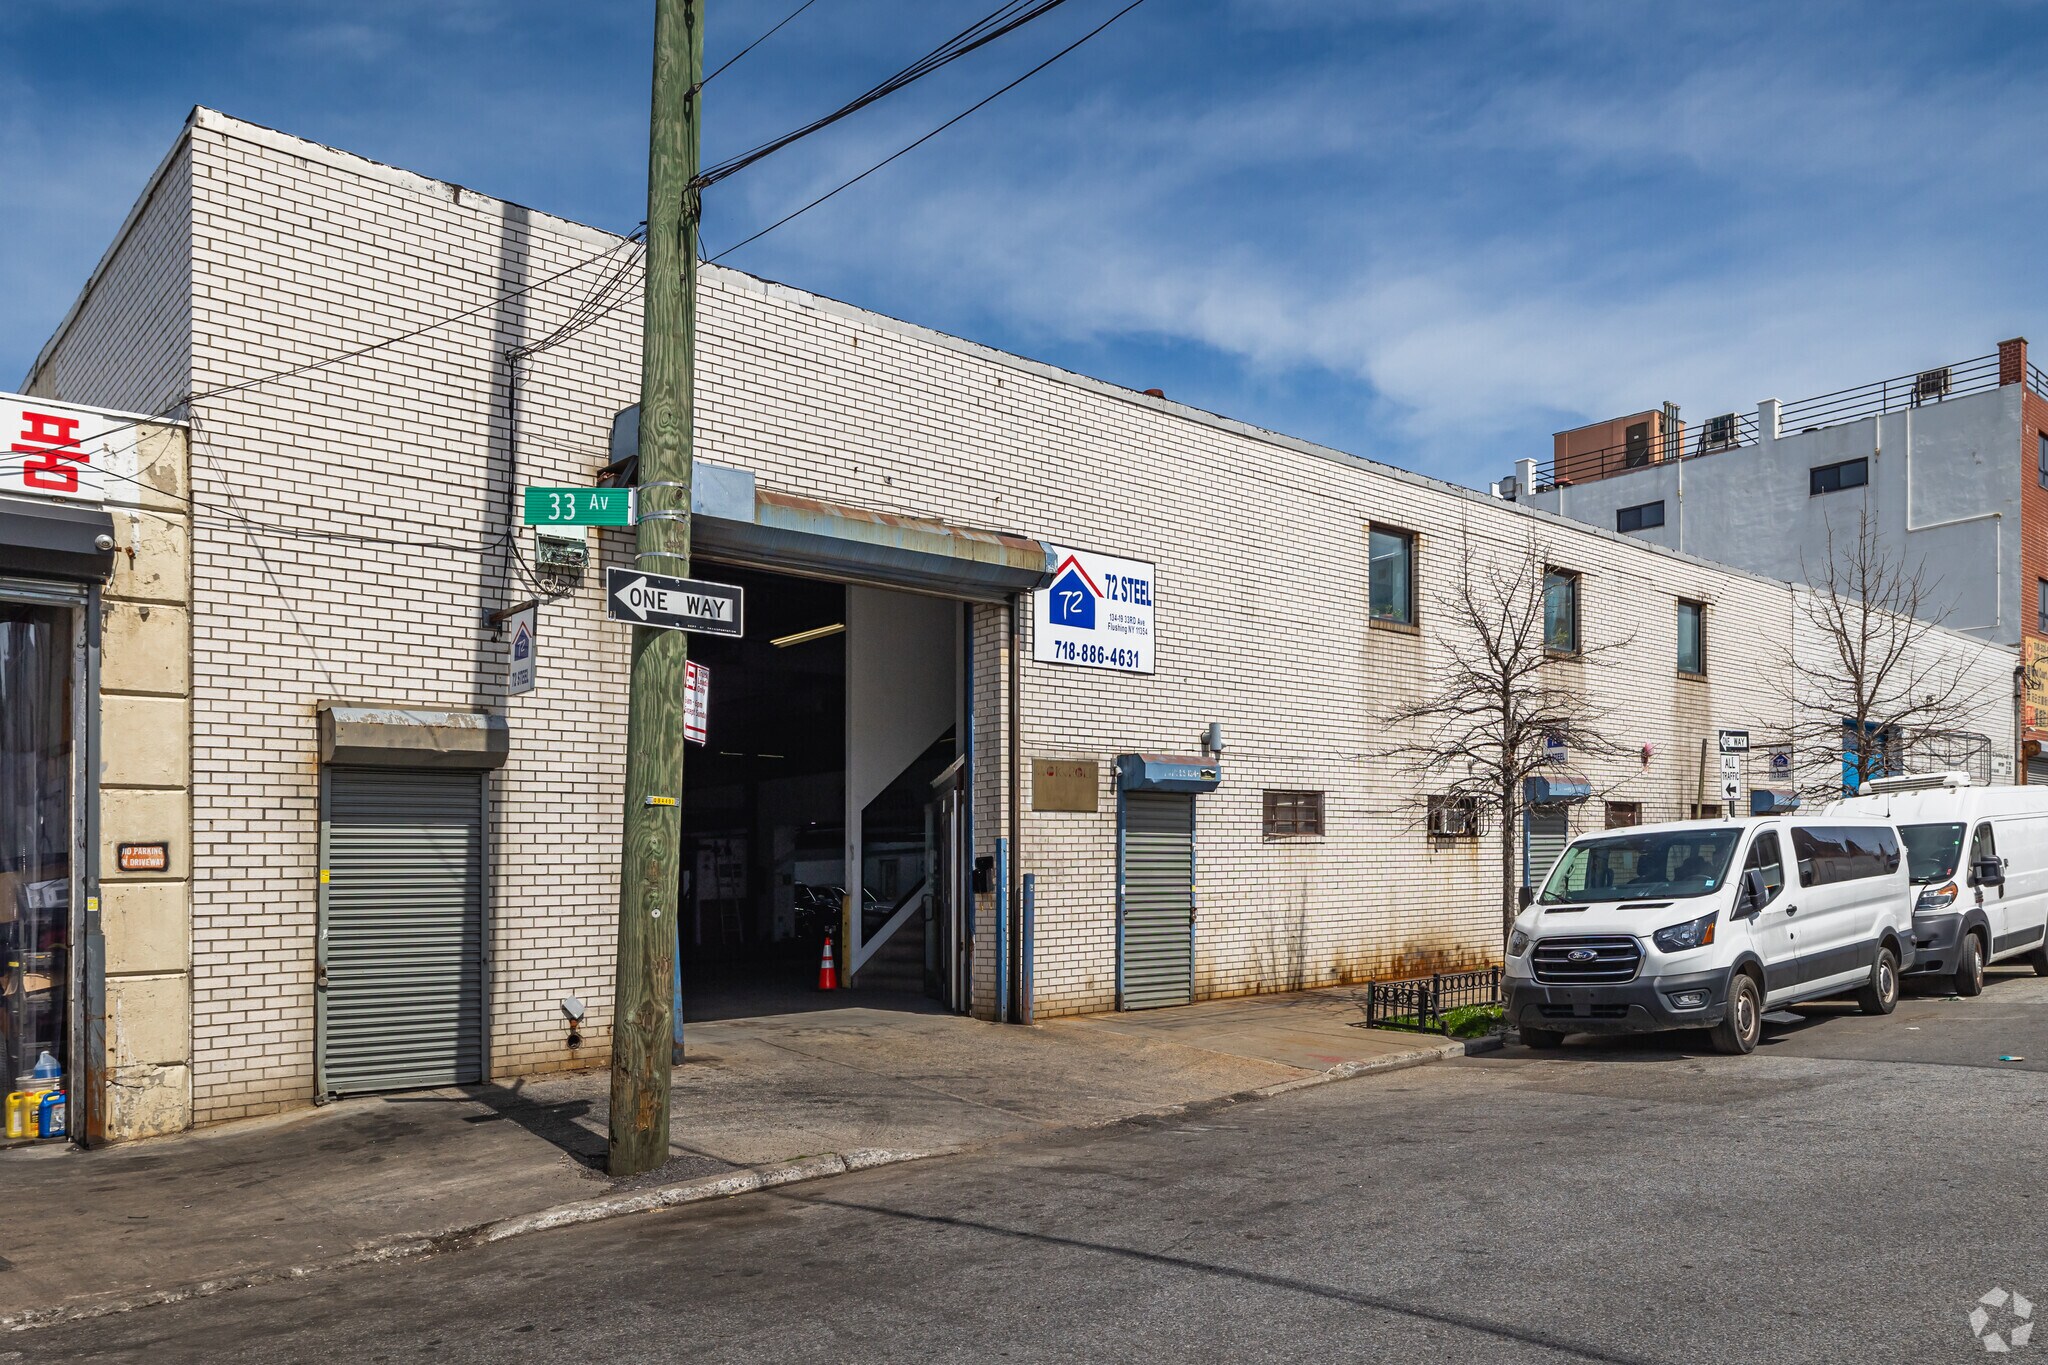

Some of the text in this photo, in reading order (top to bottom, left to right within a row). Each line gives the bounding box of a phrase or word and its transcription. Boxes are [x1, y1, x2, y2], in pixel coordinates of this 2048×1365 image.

[11, 411, 90, 493] 품
[548, 493, 609, 520] 33 Av
[1105, 573, 1152, 606] 72 STEEL
[630, 587, 725, 618] ONE WAY
[1058, 590, 1083, 620] 72
[1137, 617, 1146, 626] Ave
[1107, 622, 1128, 635] Flushing
[1128, 625, 1136, 634] NY
[1054, 639, 1139, 668] 718-886-4631
[1722, 736, 1745, 746] ONE WAY
[1725, 757, 1736, 769] ALL
[1722, 771, 1739, 780] TRAFFIC
[133, 847, 163, 855] PARKING
[129, 858, 165, 866] DRIVEWAY
